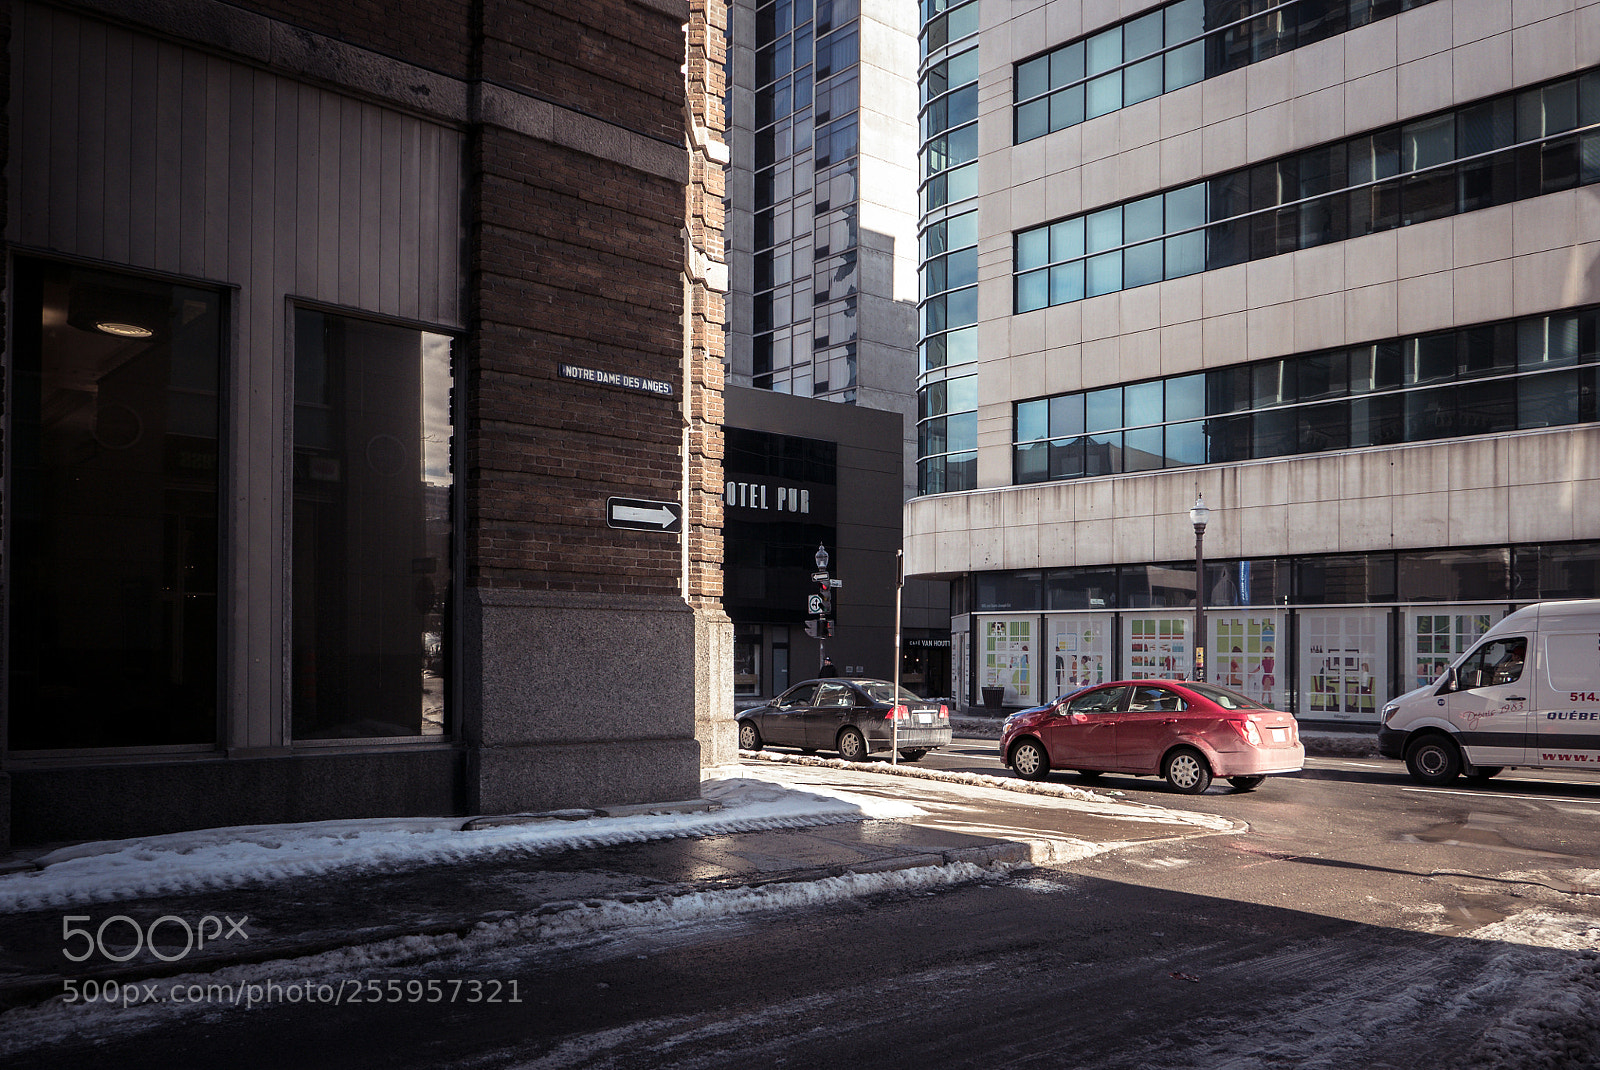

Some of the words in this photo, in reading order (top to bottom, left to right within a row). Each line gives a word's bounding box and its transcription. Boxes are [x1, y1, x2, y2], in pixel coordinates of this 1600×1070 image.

[566, 366, 595, 380] NOTRE
[597, 371, 621, 385] DAME
[623, 377, 640, 388] DES
[642, 380, 669, 393] ANGES
[726, 481, 769, 509] OTEL
[777, 487, 810, 513] PUR
[1570, 692, 1600, 702] 514.
[1498, 702, 1524, 714] 1983
[1546, 711, 1600, 721] QUÉBE
